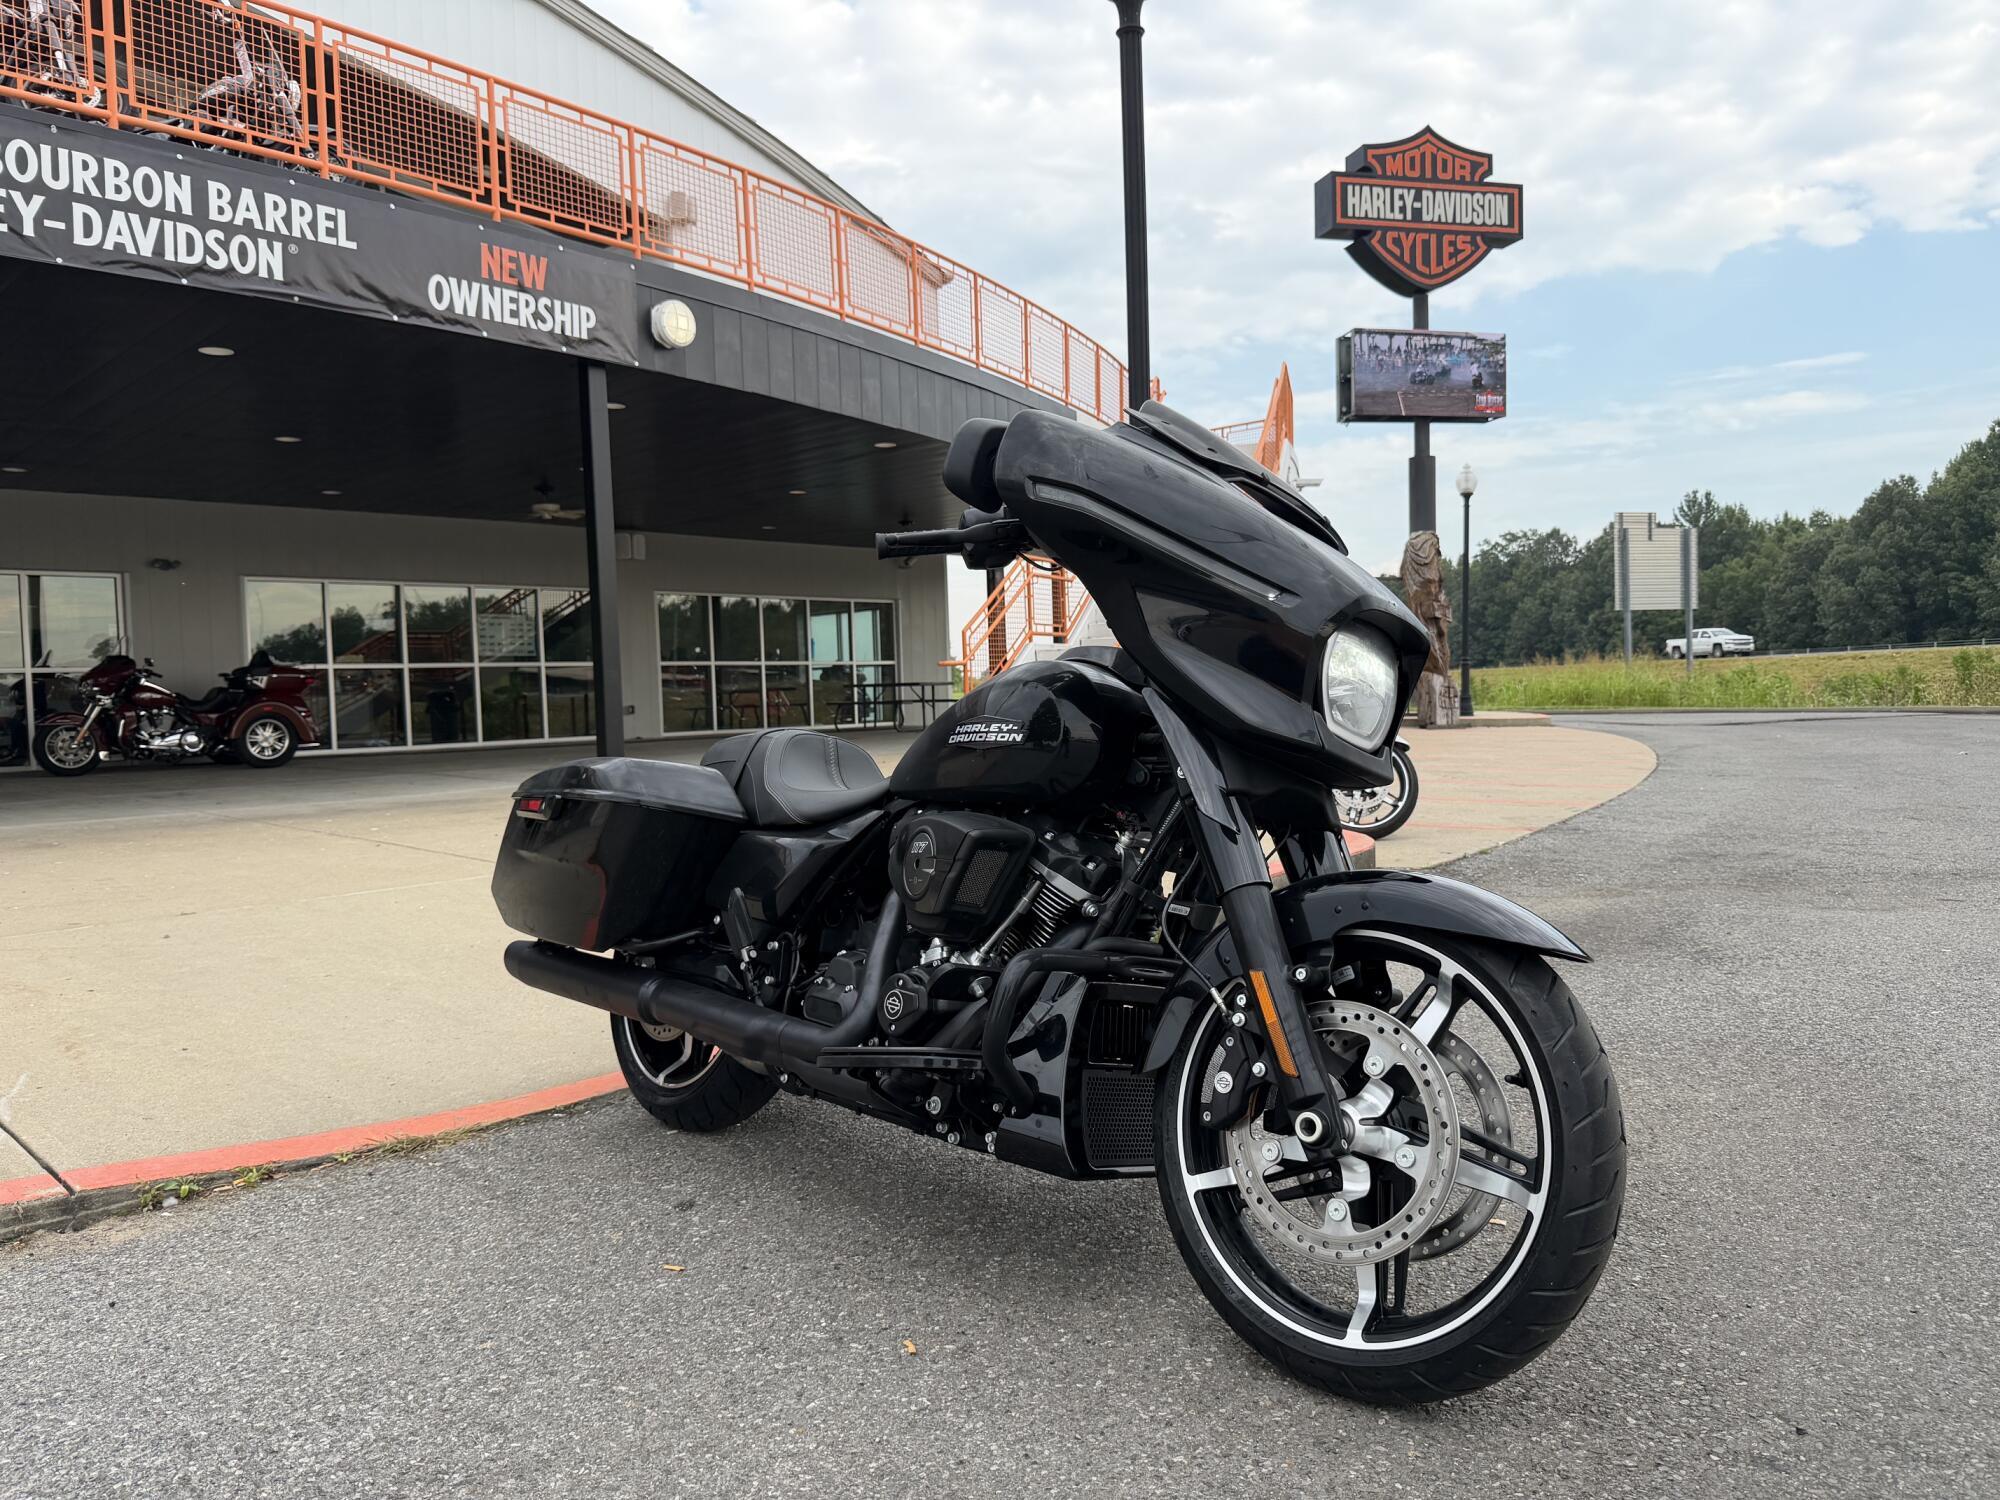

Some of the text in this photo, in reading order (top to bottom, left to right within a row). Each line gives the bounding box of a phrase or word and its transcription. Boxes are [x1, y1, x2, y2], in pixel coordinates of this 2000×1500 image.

[1386, 143, 1472, 182] MOTOR
[0, 138, 358, 250] OURBON BARREL
[1347, 184, 1509, 226] HARLEY-DAVIDSON
[480, 242, 548, 290] NEW
[1386, 230, 1473, 275] CYCLES
[428, 274, 597, 340] OWNERSHIP
[949, 732, 1024, 744] DAVIDSON
[955, 723, 1019, 733] HARLEY-
